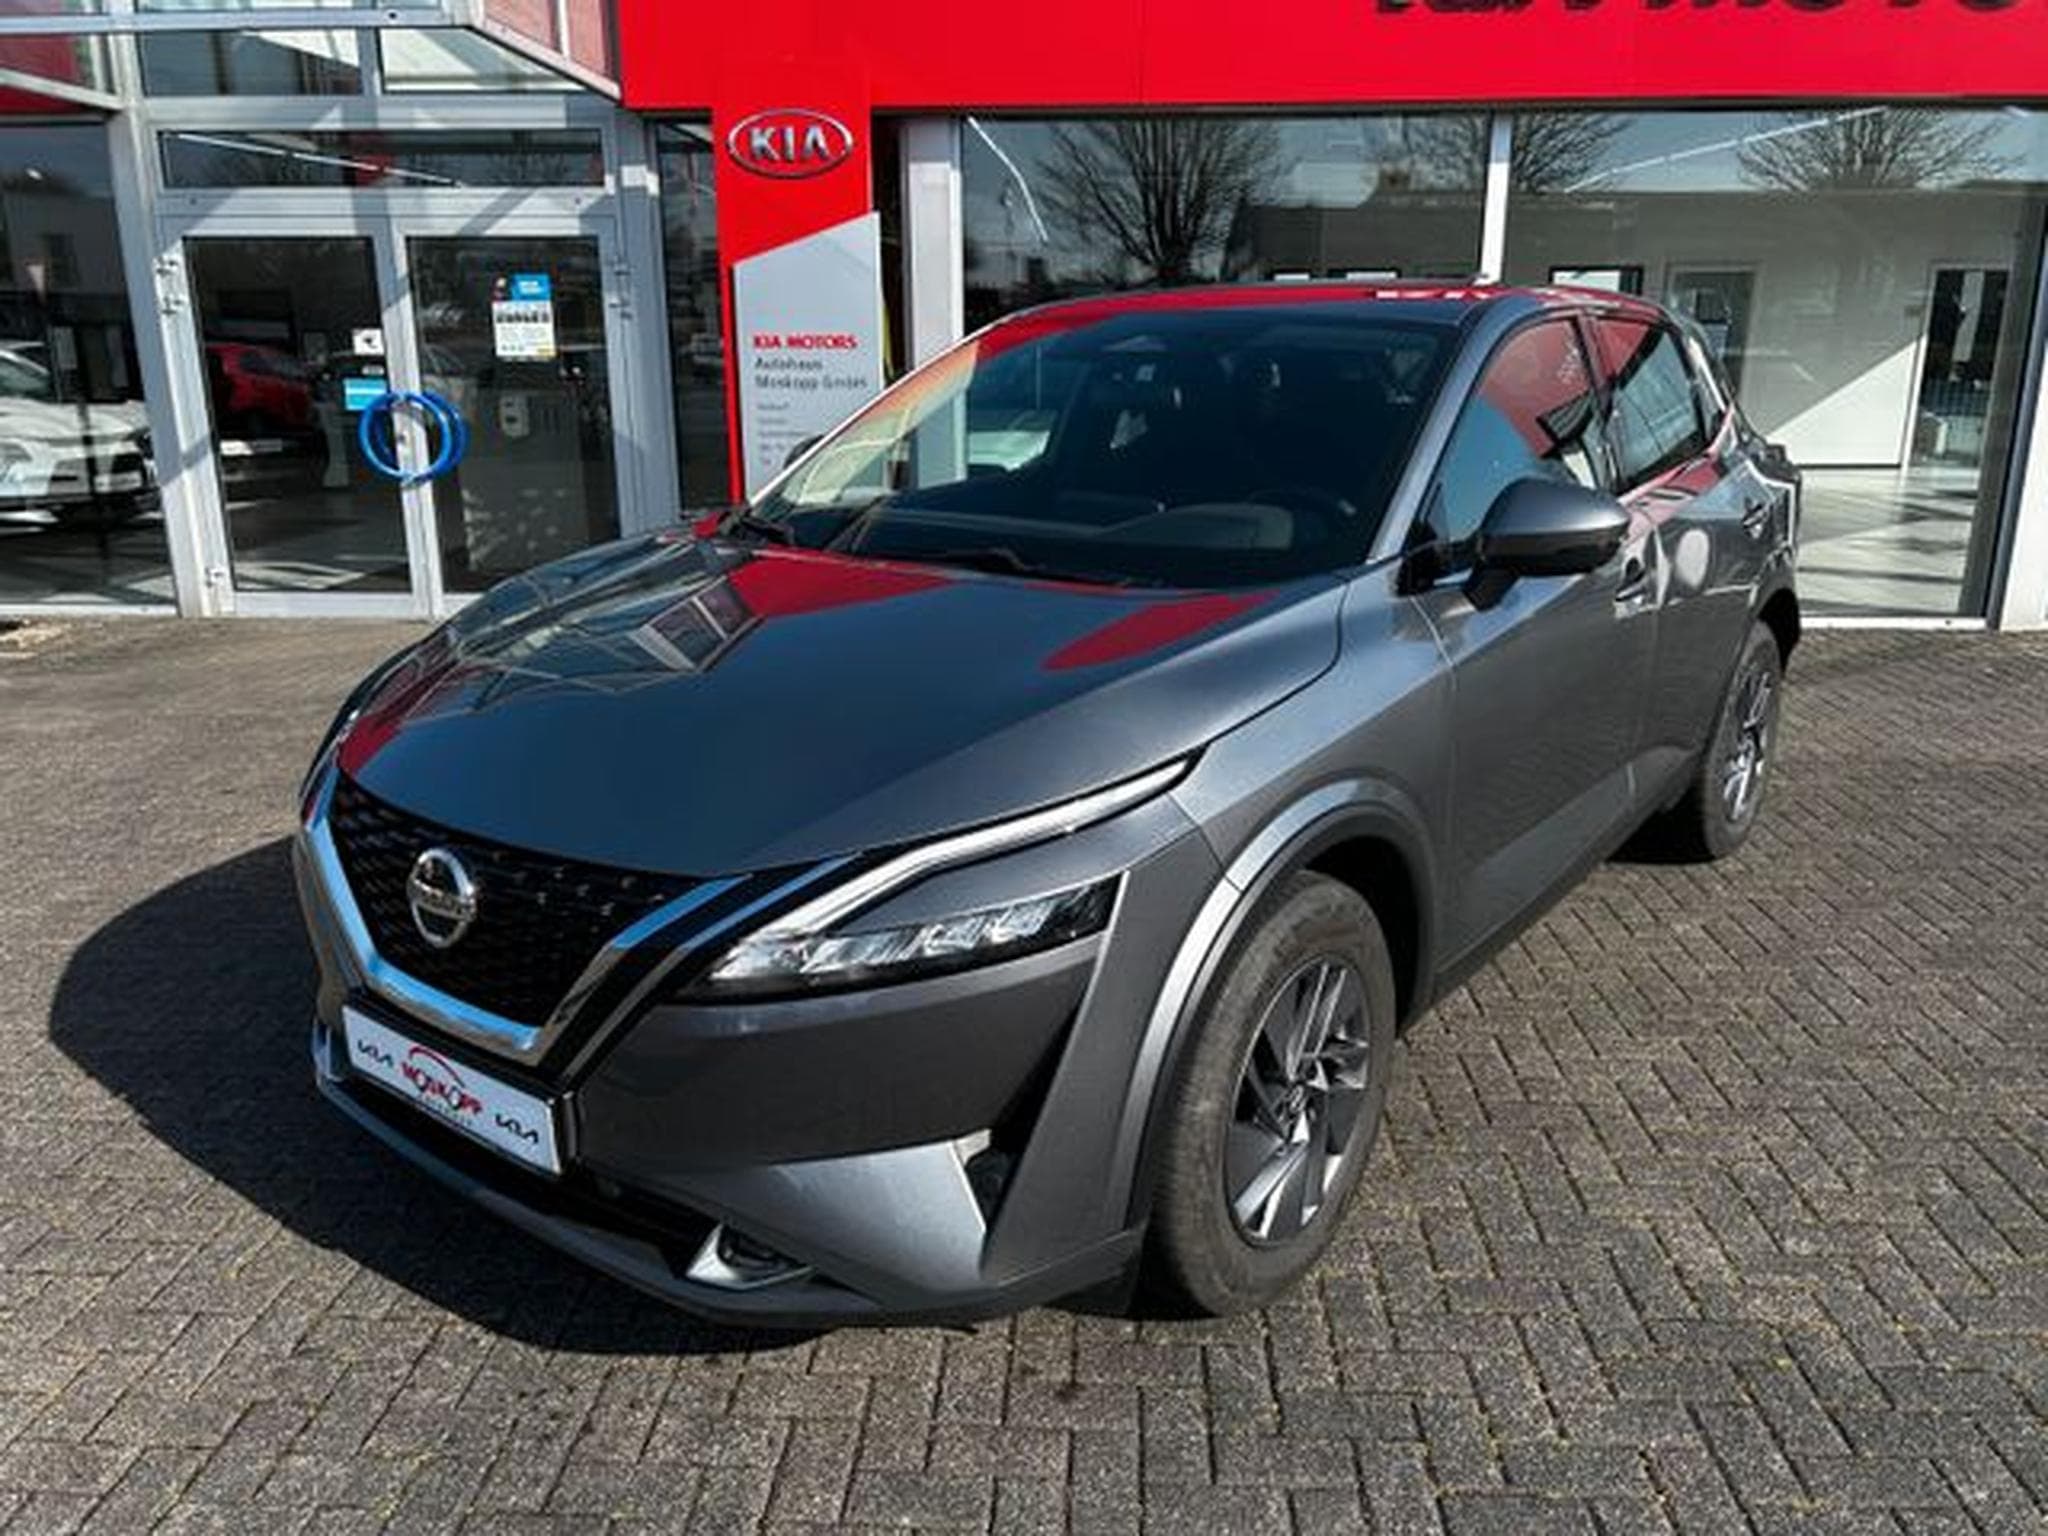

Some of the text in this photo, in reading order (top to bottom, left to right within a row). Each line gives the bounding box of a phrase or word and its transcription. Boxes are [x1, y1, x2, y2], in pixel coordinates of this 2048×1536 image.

[750, 125, 831, 162] KIA
[753, 335, 858, 349] KIA MOTORS
[755, 358, 824, 370] Autohaus
[495, 1113, 540, 1144] KIA
